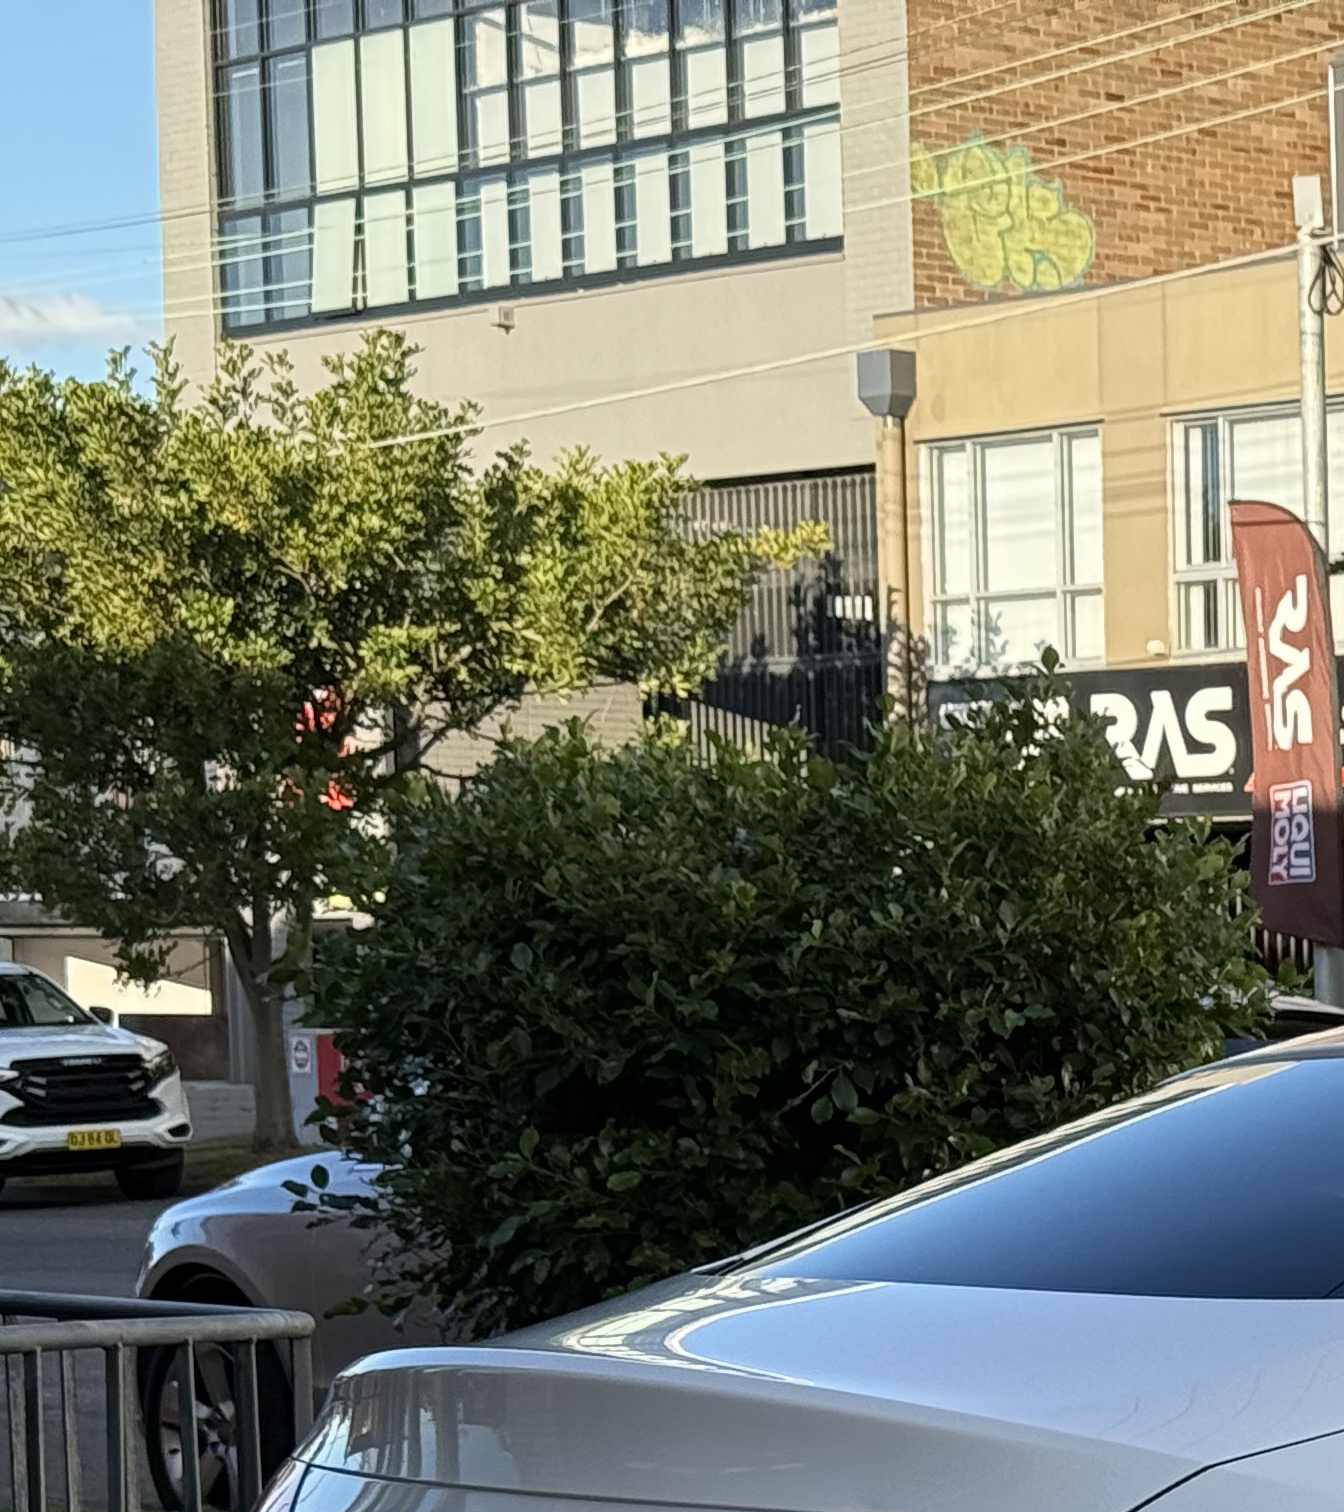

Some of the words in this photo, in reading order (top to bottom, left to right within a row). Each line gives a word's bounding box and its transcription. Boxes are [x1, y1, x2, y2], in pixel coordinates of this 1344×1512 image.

[1269, 574, 1312, 750] RAS
[1090, 686, 1237, 781] RAS
[1271, 790, 1290, 882] MOLY
[1290, 787, 1312, 880] LIQUI
